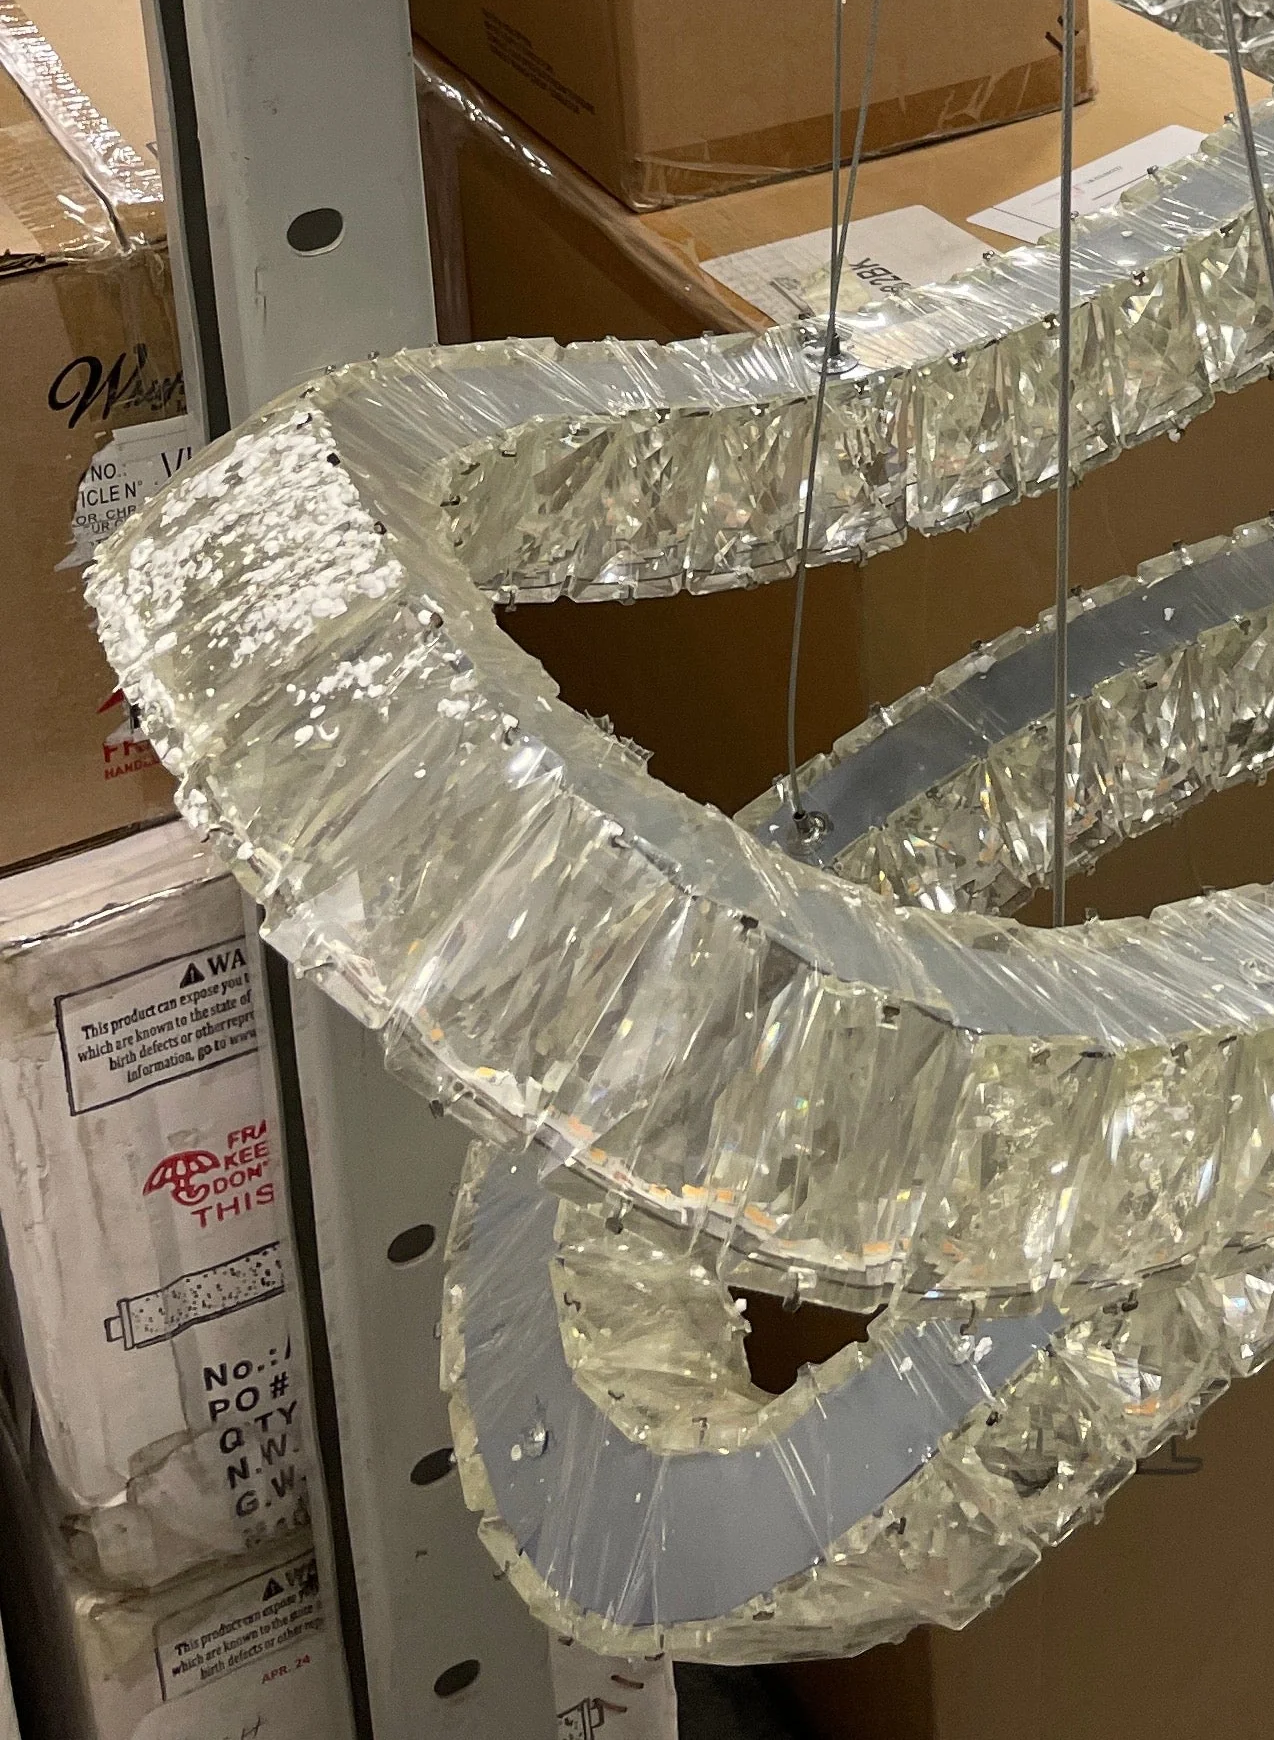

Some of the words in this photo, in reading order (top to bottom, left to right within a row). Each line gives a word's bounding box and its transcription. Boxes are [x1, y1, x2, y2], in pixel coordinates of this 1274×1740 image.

[80, 485, 121, 509] ICLE
[77, 1040, 114, 1063] which
[115, 1033, 134, 1049] are
[135, 1019, 174, 1043] known
[175, 1014, 188, 1028] to
[190, 1006, 209, 1025] the
[210, 997, 237, 1016] state
[239, 988, 252, 1005] of
[81, 1020, 109, 1040] This
[111, 1005, 156, 1036] product
[157, 998, 177, 1014] can
[180, 984, 219, 1007] expose
[221, 975, 243, 996] you
[108, 1049, 137, 1072] birth
[139, 1035, 179, 1059] defects
[180, 1030, 193, 1045] or
[195, 1021, 227, 1040] other
[197, 1043, 213, 1061] go
[213, 1036, 227, 1051] to
[223, 1140, 269, 1170] KEE
[227, 1118, 267, 1150] FR
[213, 1159, 269, 1194] DON
[190, 1182, 275, 1228] THIS
[219, 1400, 298, 1454] QTY
[171, 1654, 205, 1678] which
[205, 1646, 223, 1659] are
[223, 1629, 259, 1653] known
[259, 1624, 271, 1637] to
[271, 1616, 289, 1631] the
[174, 1638, 200, 1656] This
[200, 1620, 243, 1649] product
[243, 1611, 262, 1625] can
[262, 1594, 298, 1617] expose
[200, 1660, 226, 1681] birth
[228, 1642, 263, 1667] defects
[264, 1637, 275, 1650] or
